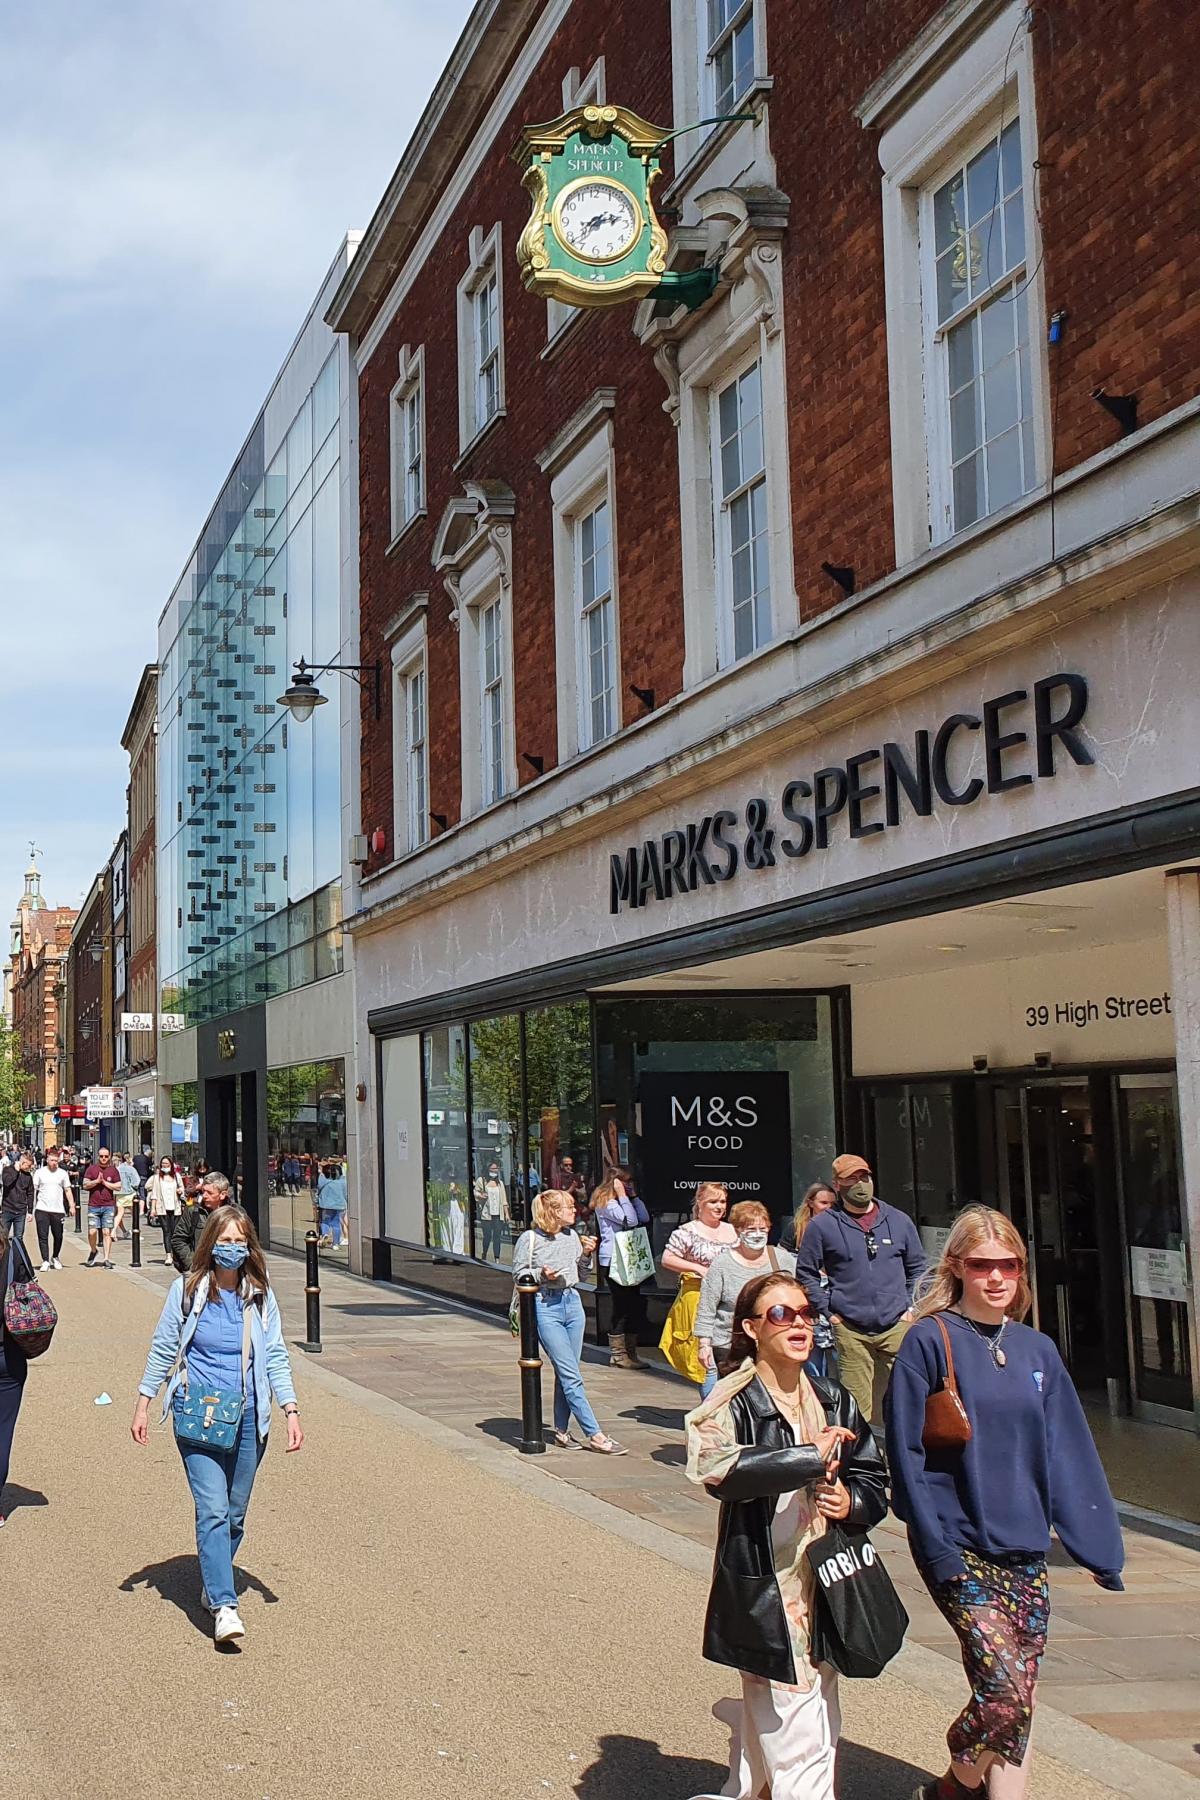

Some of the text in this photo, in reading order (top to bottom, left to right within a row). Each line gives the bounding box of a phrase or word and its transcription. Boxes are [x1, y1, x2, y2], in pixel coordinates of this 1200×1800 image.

[574, 143, 619, 155] MARKS
[568, 159, 623, 172] SPENCER
[610, 673, 1096, 914] MARKS & SPENCER
[1026, 992, 1171, 1028] 39 High Street
[671, 1096, 758, 1127] M&S
[688, 1136, 743, 1149] FOOD
[673, 1180, 760, 1191] LOWE ROUND
